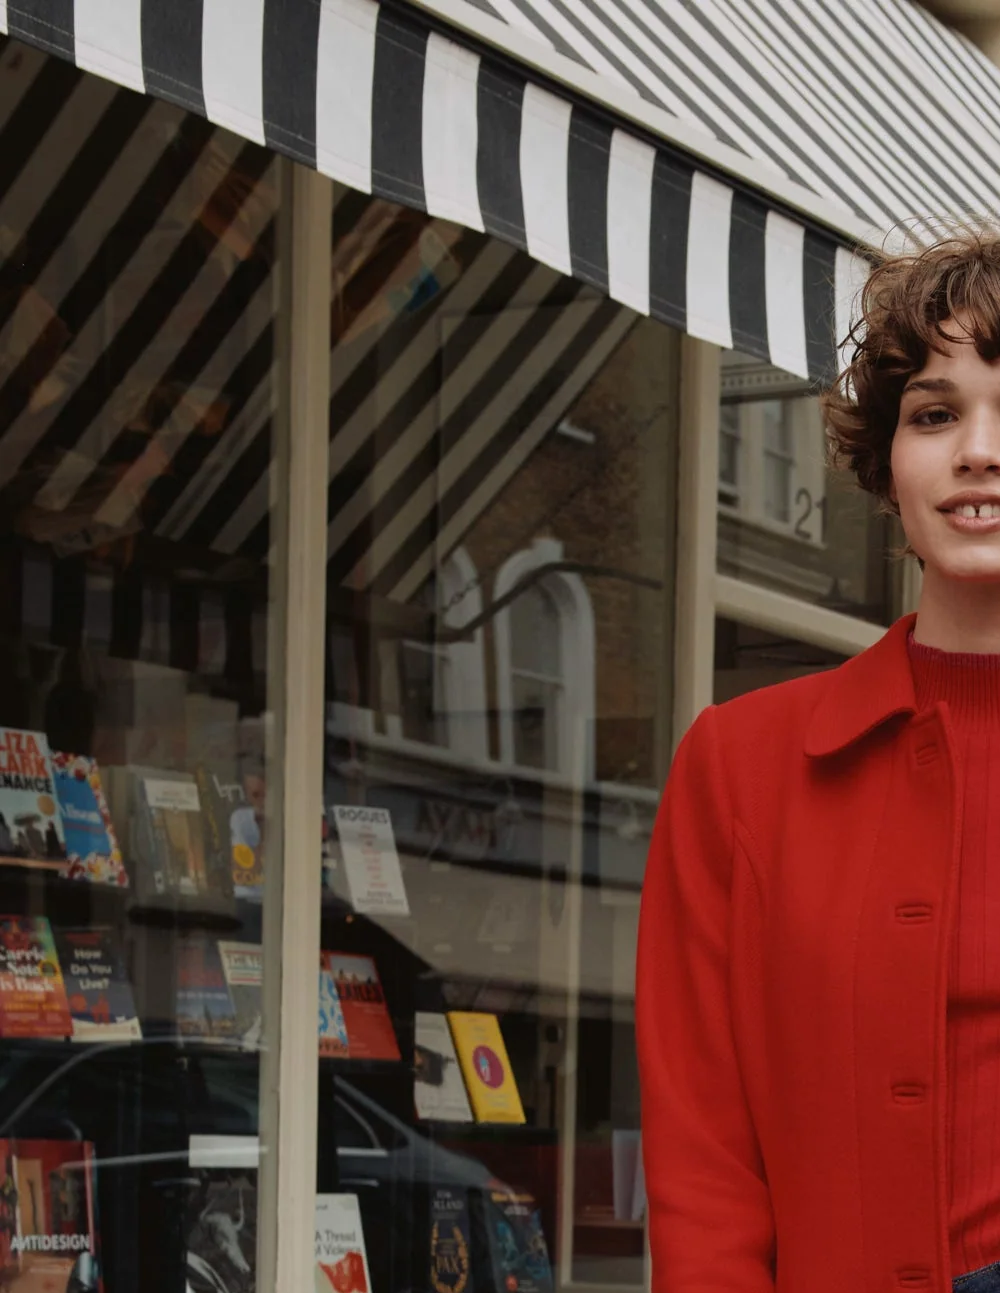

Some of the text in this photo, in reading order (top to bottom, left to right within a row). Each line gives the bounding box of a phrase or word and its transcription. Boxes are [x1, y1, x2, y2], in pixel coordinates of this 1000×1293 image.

[0, 731, 41, 756] IZA
[337, 807, 388, 824] ROGUES
[10, 1233, 90, 1251] ANTIDESIGN
